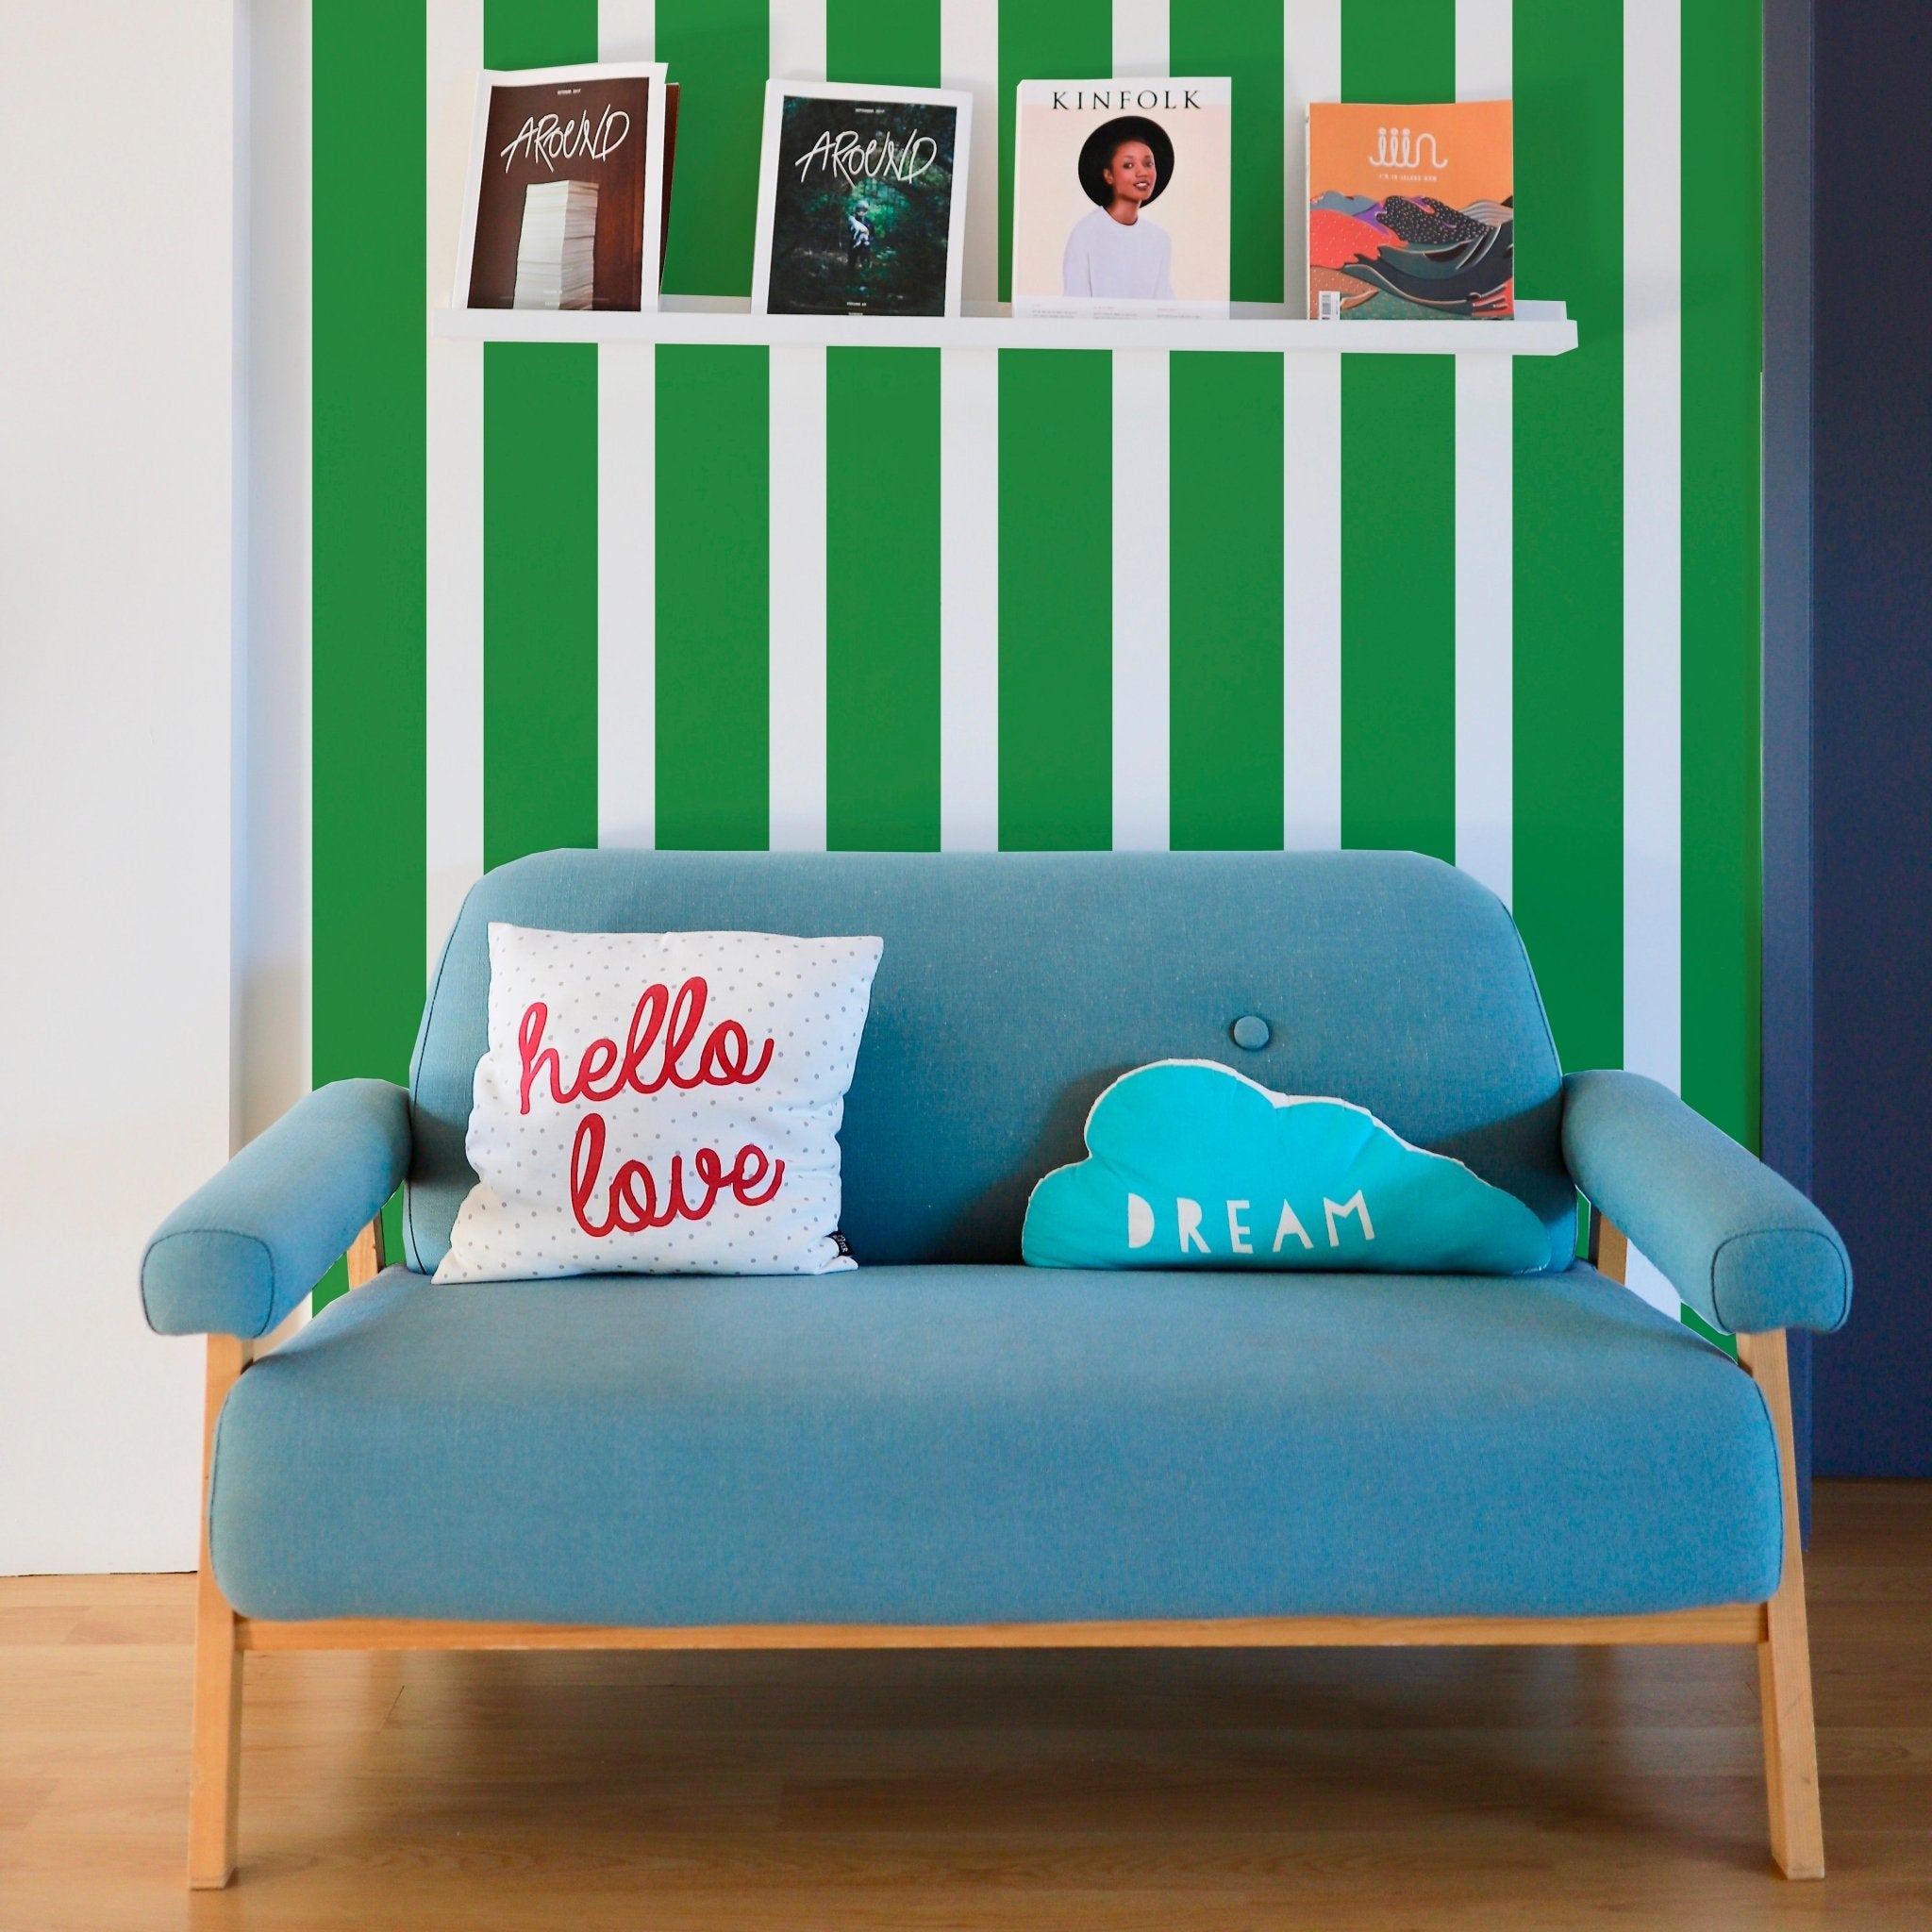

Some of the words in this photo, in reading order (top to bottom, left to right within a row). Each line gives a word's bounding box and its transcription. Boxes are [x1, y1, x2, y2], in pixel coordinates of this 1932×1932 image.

[1053, 91, 1201, 110] KINFOLK
[500, 103, 630, 174] AROUND
[794, 128, 938, 192] AROUND
[518, 975, 774, 1115] hello
[570, 1112, 785, 1238] love
[1127, 1190, 1374, 1254] DREAM
